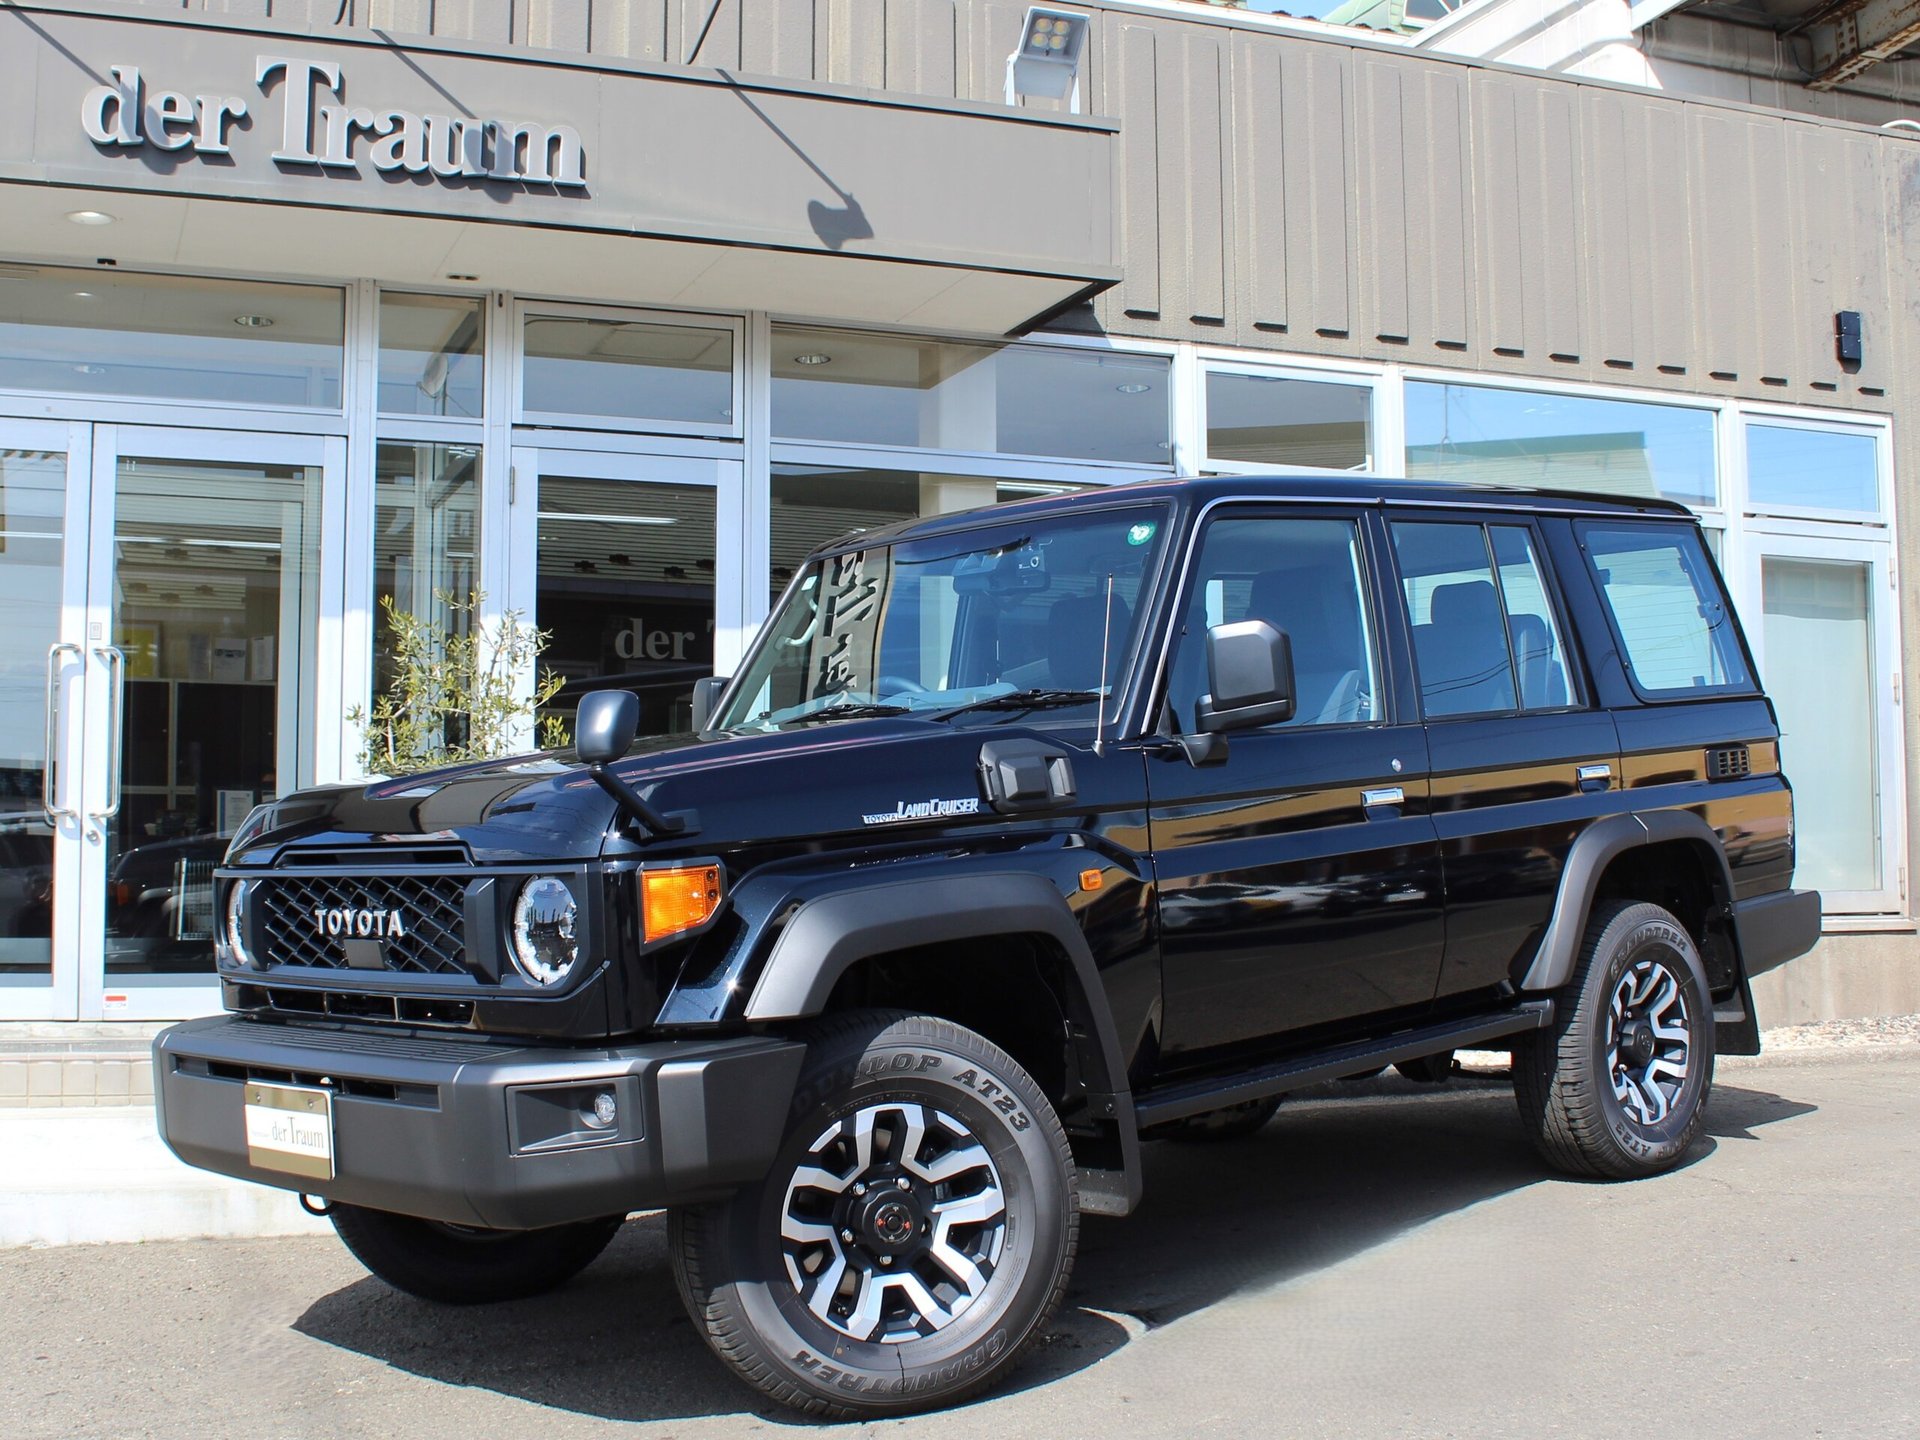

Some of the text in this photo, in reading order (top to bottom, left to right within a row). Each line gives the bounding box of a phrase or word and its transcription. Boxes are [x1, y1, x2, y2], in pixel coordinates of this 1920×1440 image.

[81, 55, 586, 187] der Traum
[614, 617, 696, 661] der
[863, 812, 898, 824] TOYOTA
[314, 908, 404, 937] TOYOTA
[952, 1068, 1032, 1133] AT23
[271, 1116, 325, 1149] der Traum
[1615, 1122, 1652, 1157] AT23
[790, 1327, 1008, 1395] GRANDTREK
